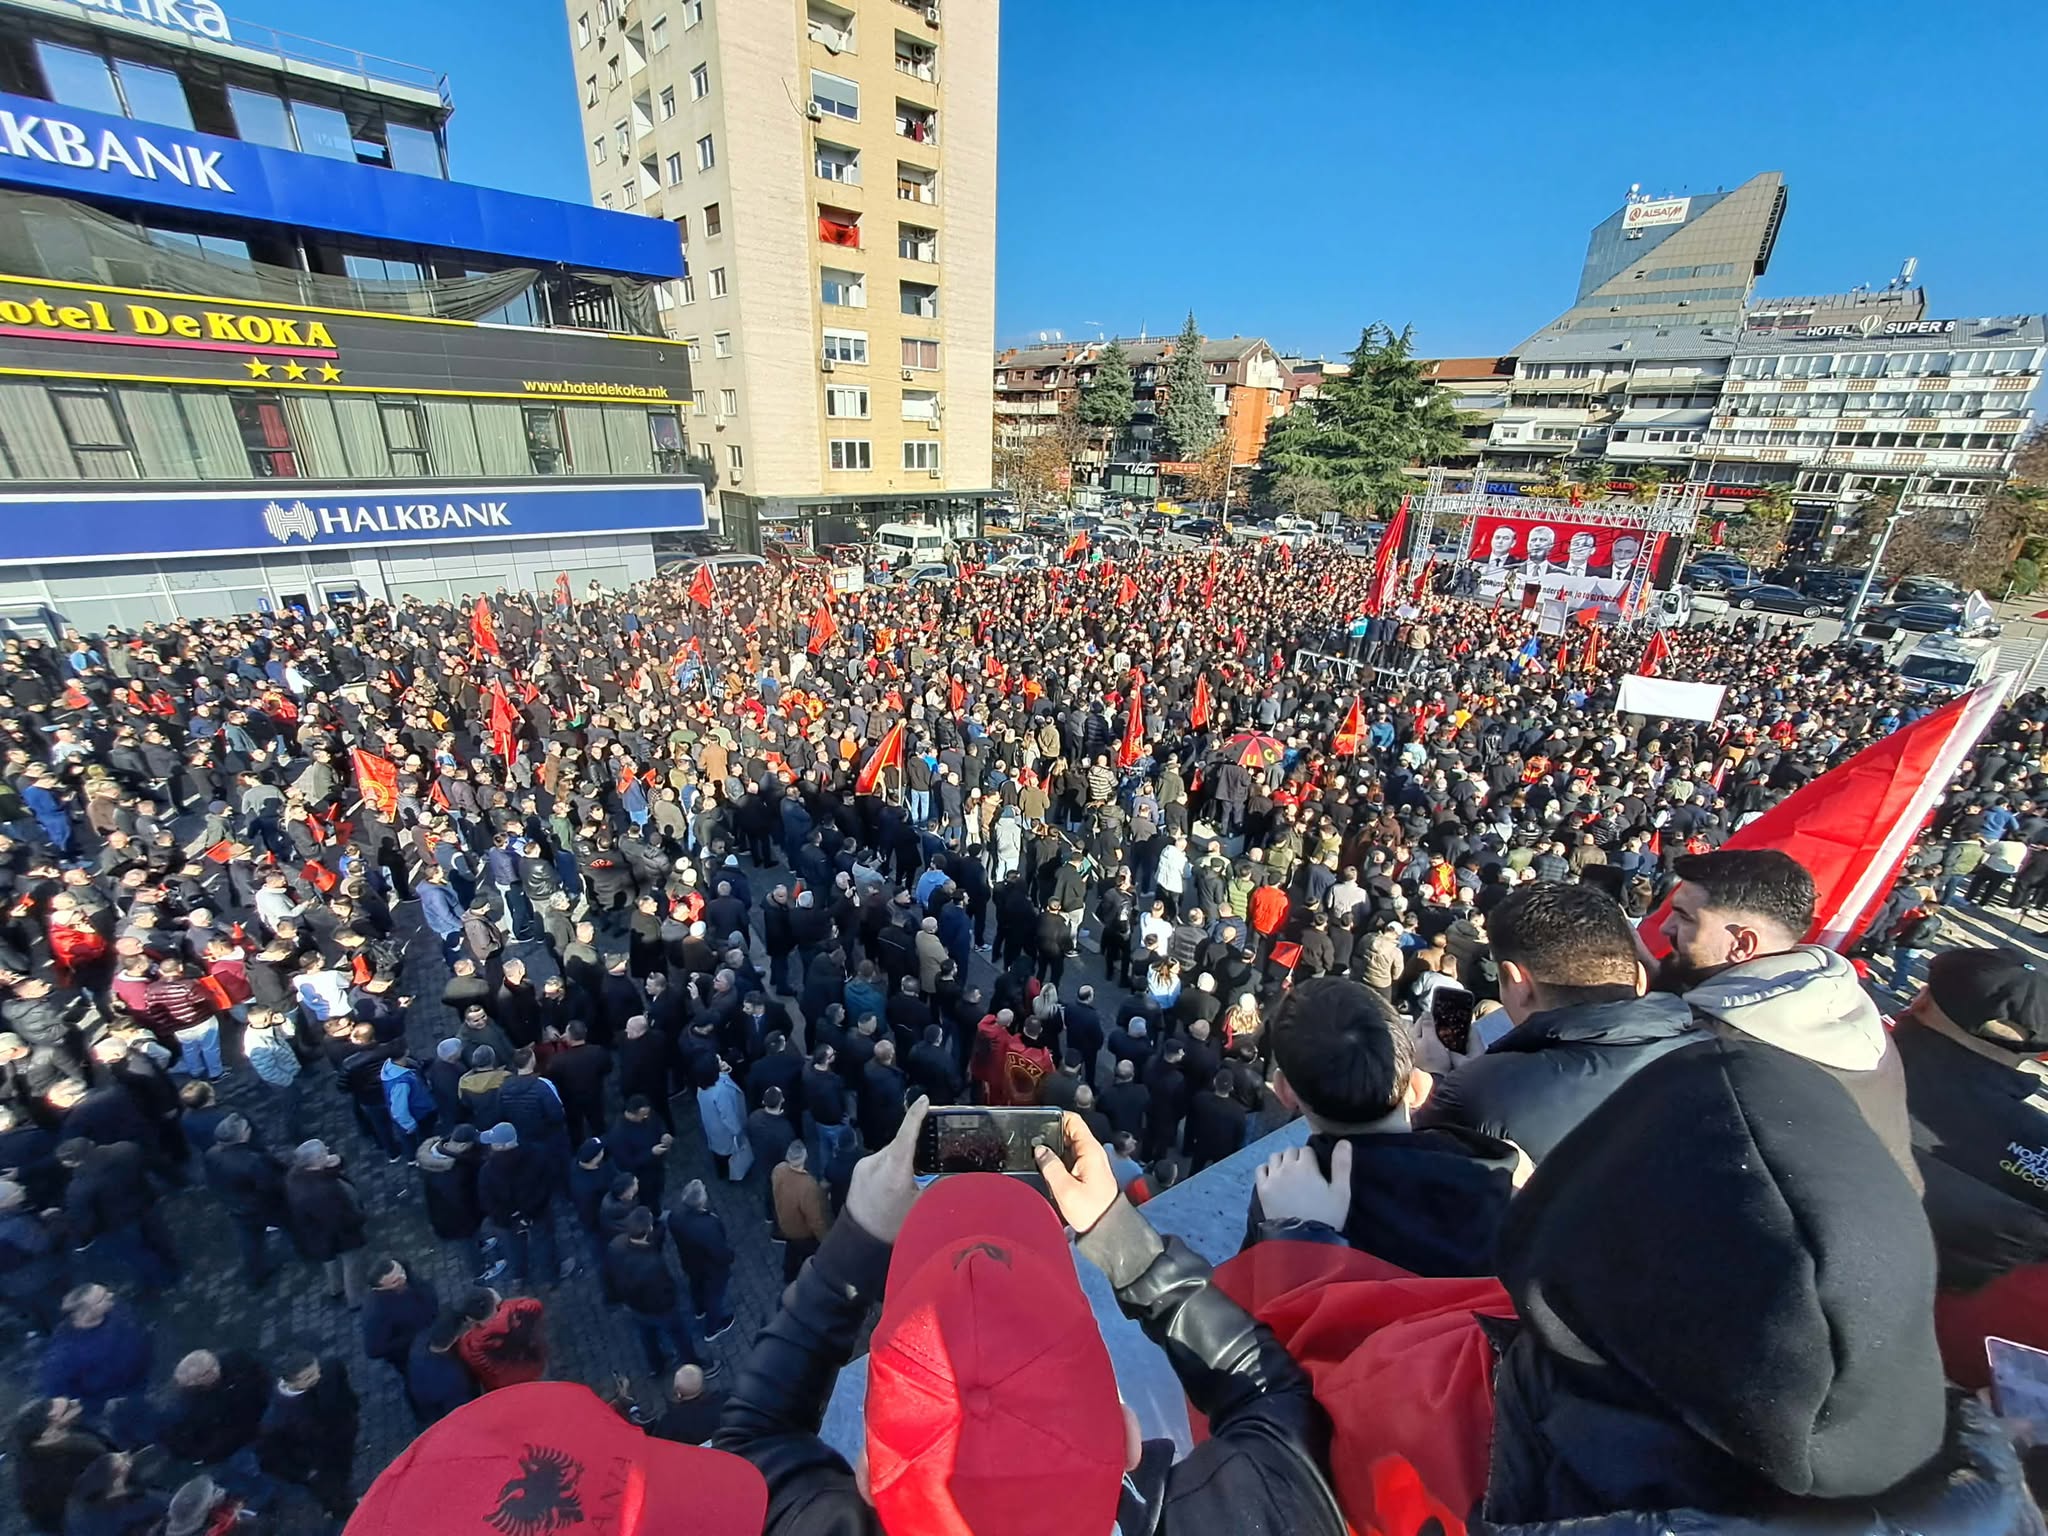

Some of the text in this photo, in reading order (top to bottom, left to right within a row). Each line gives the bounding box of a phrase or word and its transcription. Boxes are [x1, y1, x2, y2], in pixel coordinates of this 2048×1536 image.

[0, 110, 236, 194] KBANK
[0, 297, 116, 332] otel
[1807, 321, 1956, 336] HOTEL SUPER 8
[522, 380, 669, 399] www.hoteldekoka.mk
[318, 502, 512, 534] HALKBANK
